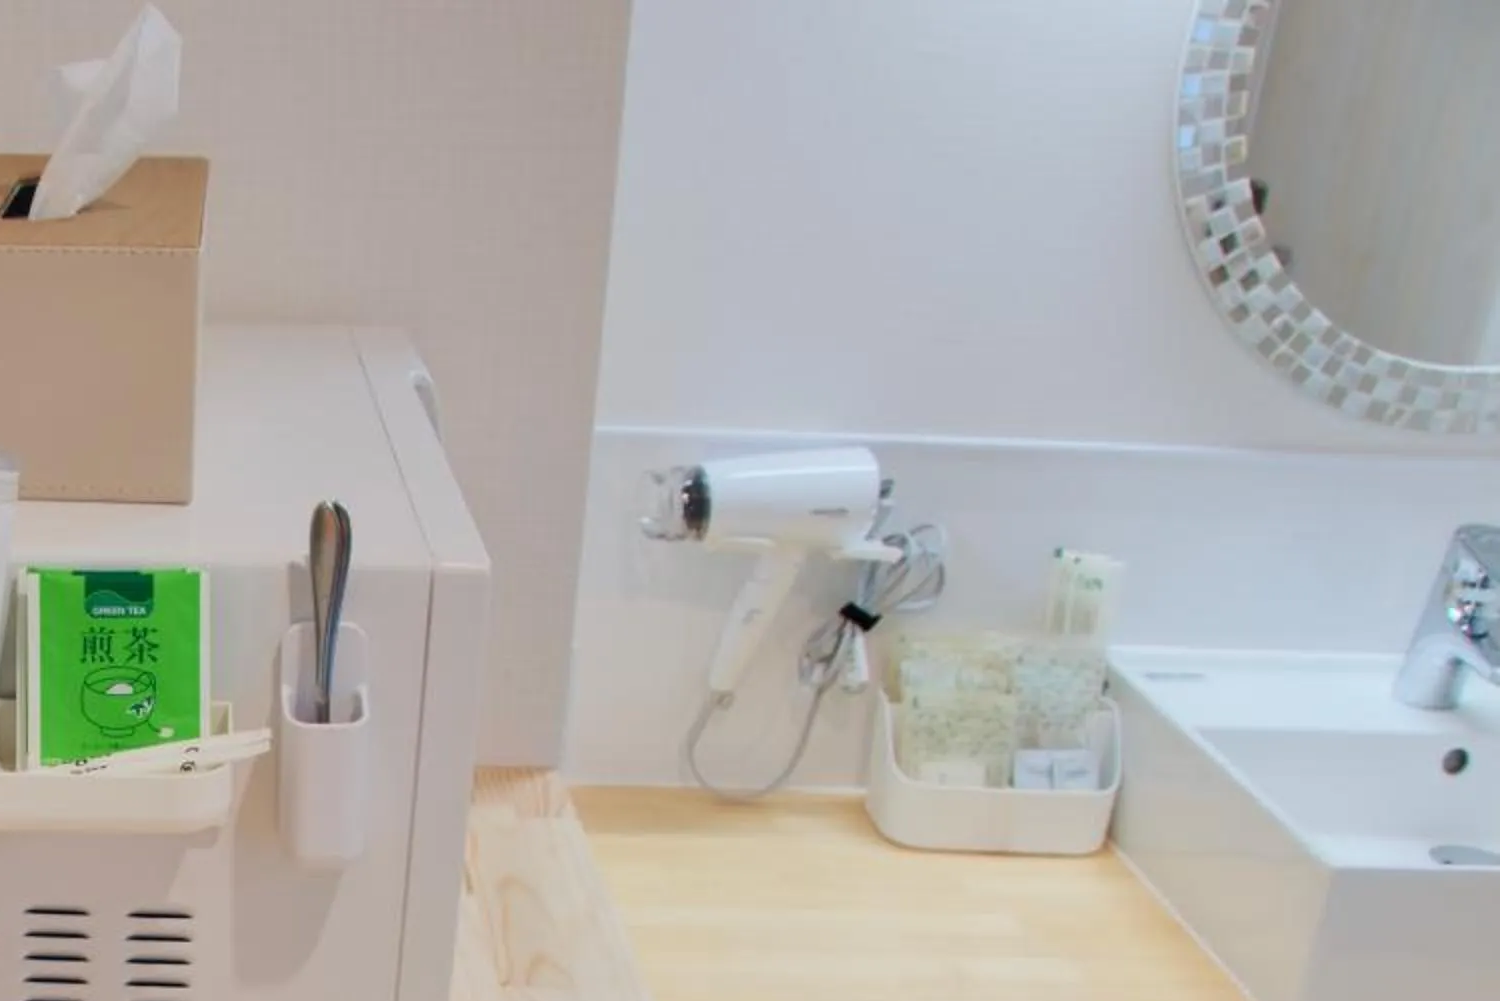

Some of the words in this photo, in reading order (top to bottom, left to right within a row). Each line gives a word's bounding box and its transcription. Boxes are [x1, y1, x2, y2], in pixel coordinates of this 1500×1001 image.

[92, 606, 126, 617] GREEN
[128, 606, 148, 616] TEA
[80, 626, 160, 665] 煎茶
